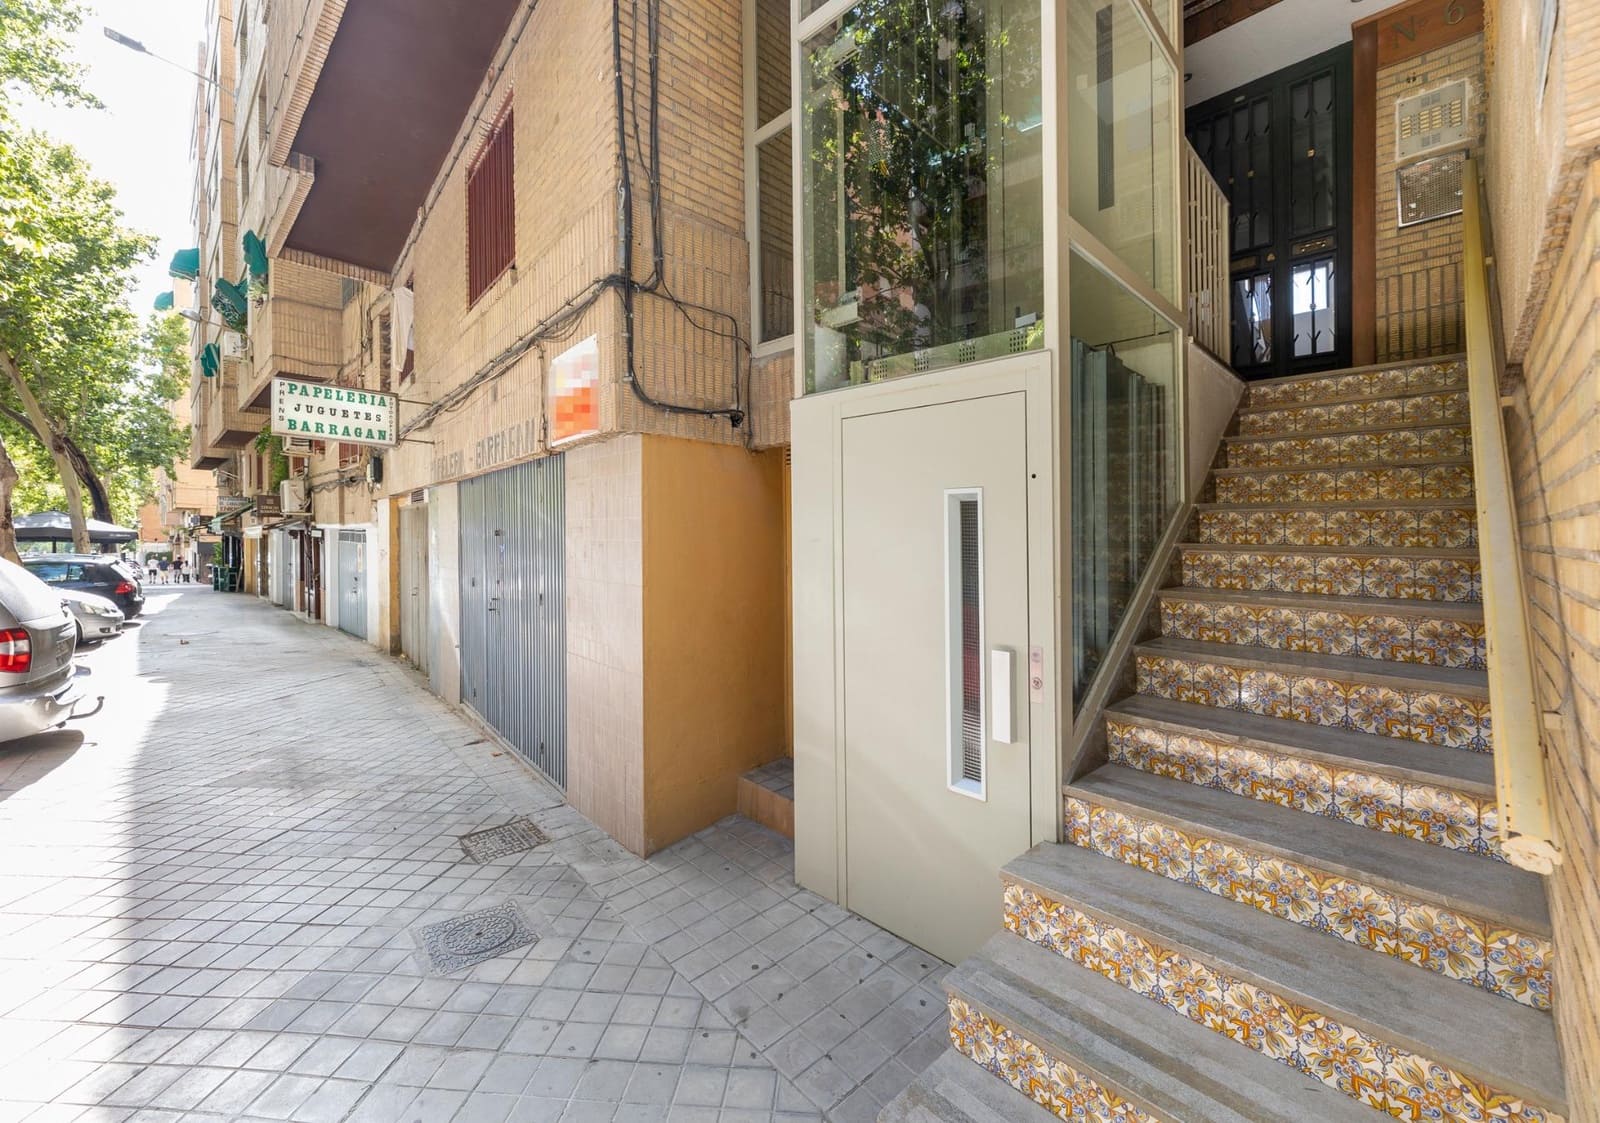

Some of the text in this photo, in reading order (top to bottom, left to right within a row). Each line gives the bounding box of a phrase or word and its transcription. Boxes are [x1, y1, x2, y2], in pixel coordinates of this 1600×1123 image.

[1443, 0, 1465, 26] 6
[287, 382, 387, 407] PAPELERIA
[294, 403, 382, 422] JUGUETES
[287, 418, 387, 441] BARRAGAN
